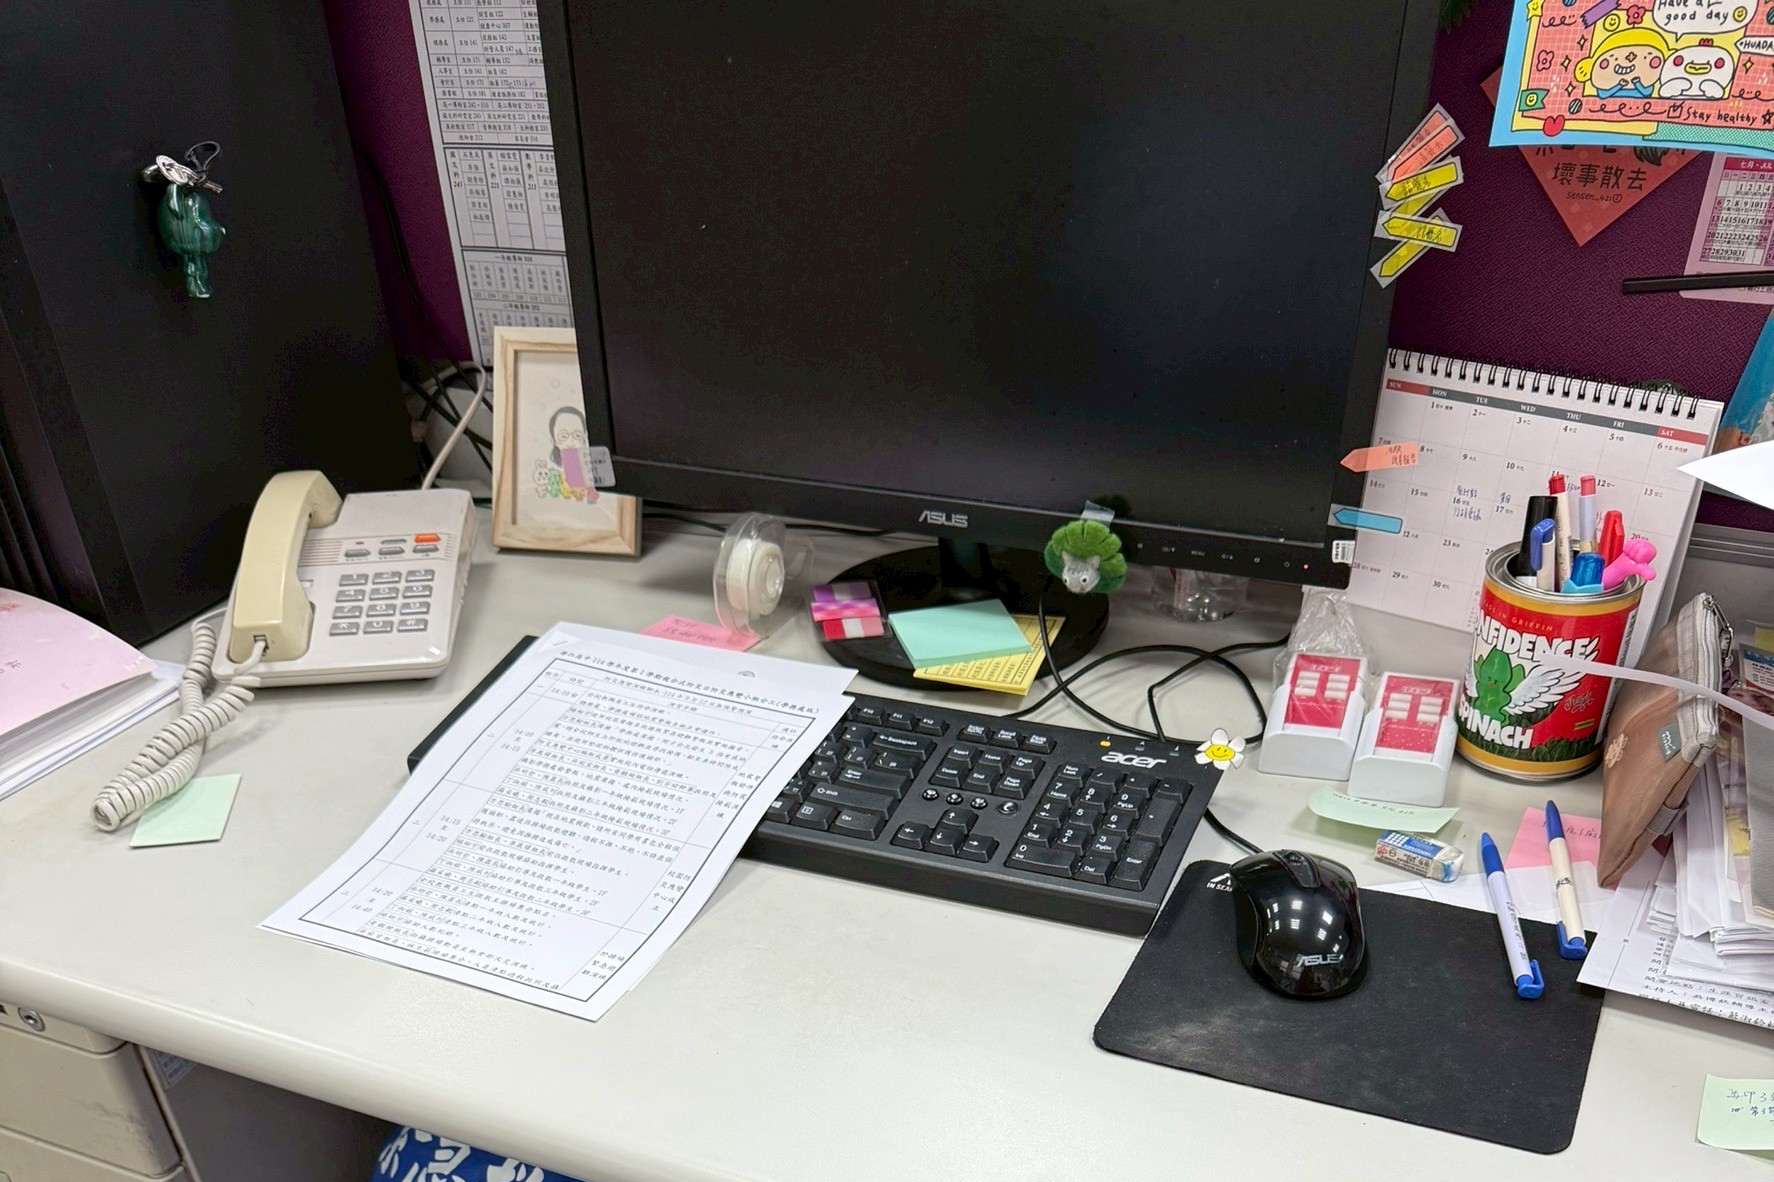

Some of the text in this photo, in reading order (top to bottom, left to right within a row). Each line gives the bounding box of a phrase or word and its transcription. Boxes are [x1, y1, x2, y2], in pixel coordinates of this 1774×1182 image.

[1665, 10, 1728, 26] good day
[1683, 106, 1757, 126] Stay healthy
[1552, 162, 1647, 191] 壞事散去
[1765, 184, 1771, 192] 4
[1760, 201, 1768, 209] 11
[1711, 215, 1720, 223] 13
[1729, 216, 1737, 224] 15
[1389, 381, 1401, 389] SUN
[1432, 389, 1448, 397] MON
[1521, 404, 1536, 412] WED
[1431, 401, 1435, 409] 1
[1566, 413, 1581, 421] THU
[1661, 429, 1674, 437] SAT
[1506, 462, 1515, 470] 10
[1370, 480, 1378, 488] 14
[1597, 479, 1606, 487] 12
[1644, 488, 1653, 496] 13
[1495, 505, 1504, 513] 17
[919, 510, 968, 528] ASUS
[1511, 616, 1554, 632] GRIFFIN
[888, 736, 918, 746] Backspace
[984, 753, 1001, 762] Home
[1018, 757, 1033, 765] Page
[1101, 751, 1167, 768] acer
[1065, 764, 1079, 772] Num
[847, 769, 862, 777] Enter
[1054, 782, 1062, 790] 7
[1088, 787, 1095, 795] 8
[1043, 803, 1050, 811] 4
[1117, 801, 1134, 809] PgUp
[438, 815, 462, 825] 14:15
[1110, 814, 1117, 822] 6
[423, 832, 448, 843] 14:20
[1027, 831, 1040, 839] End
[1065, 829, 1073, 838] 2
[1099, 835, 1107, 843] 3
[1019, 844, 1027, 852] 0
[1095, 843, 1112, 851] PgDn
[1084, 865, 1096, 873] Del
[1295, 954, 1342, 967] ASUS
